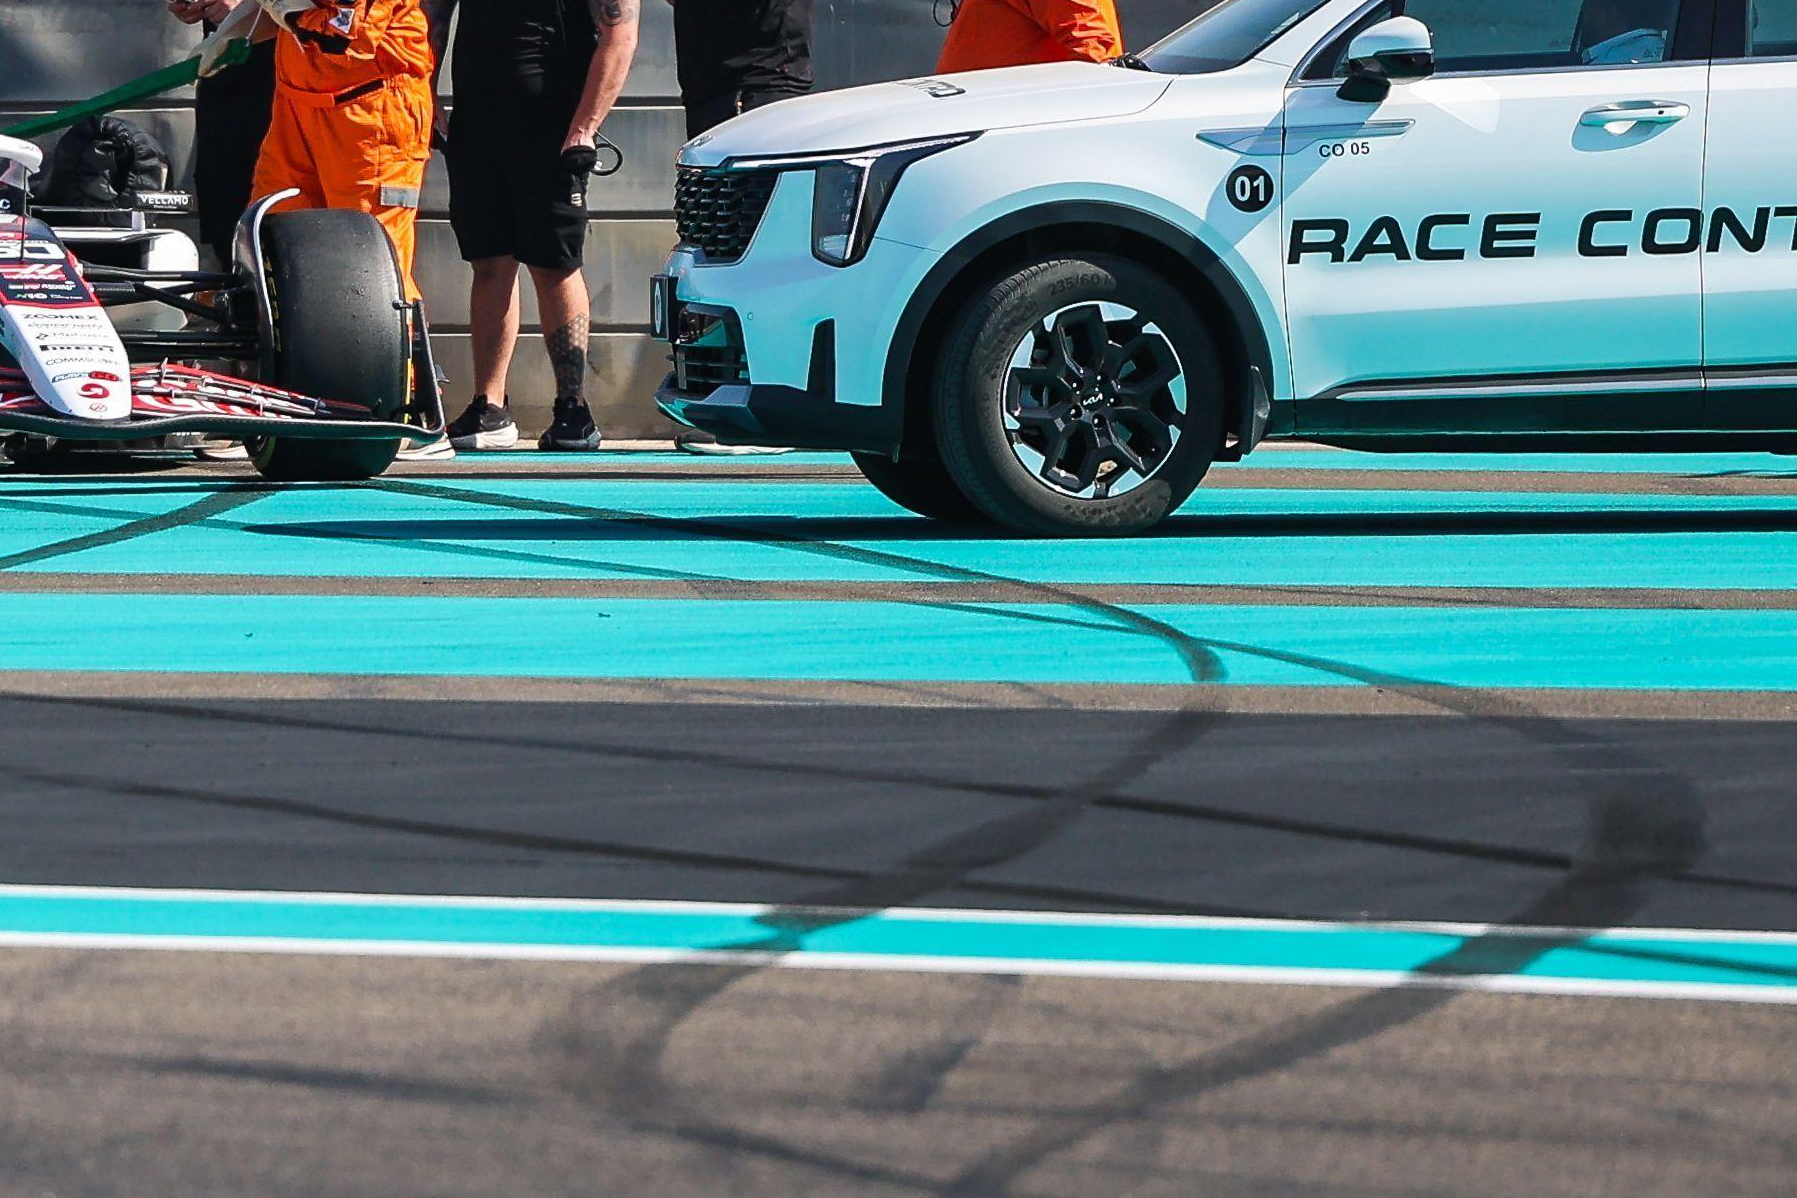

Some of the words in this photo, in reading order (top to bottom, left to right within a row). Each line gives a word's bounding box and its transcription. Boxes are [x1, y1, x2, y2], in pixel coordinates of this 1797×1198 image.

[1318, 142, 1345, 159] CO
[1350, 140, 1371, 156] 05
[1234, 175, 1266, 203] 01
[1286, 211, 1542, 265] RACE
